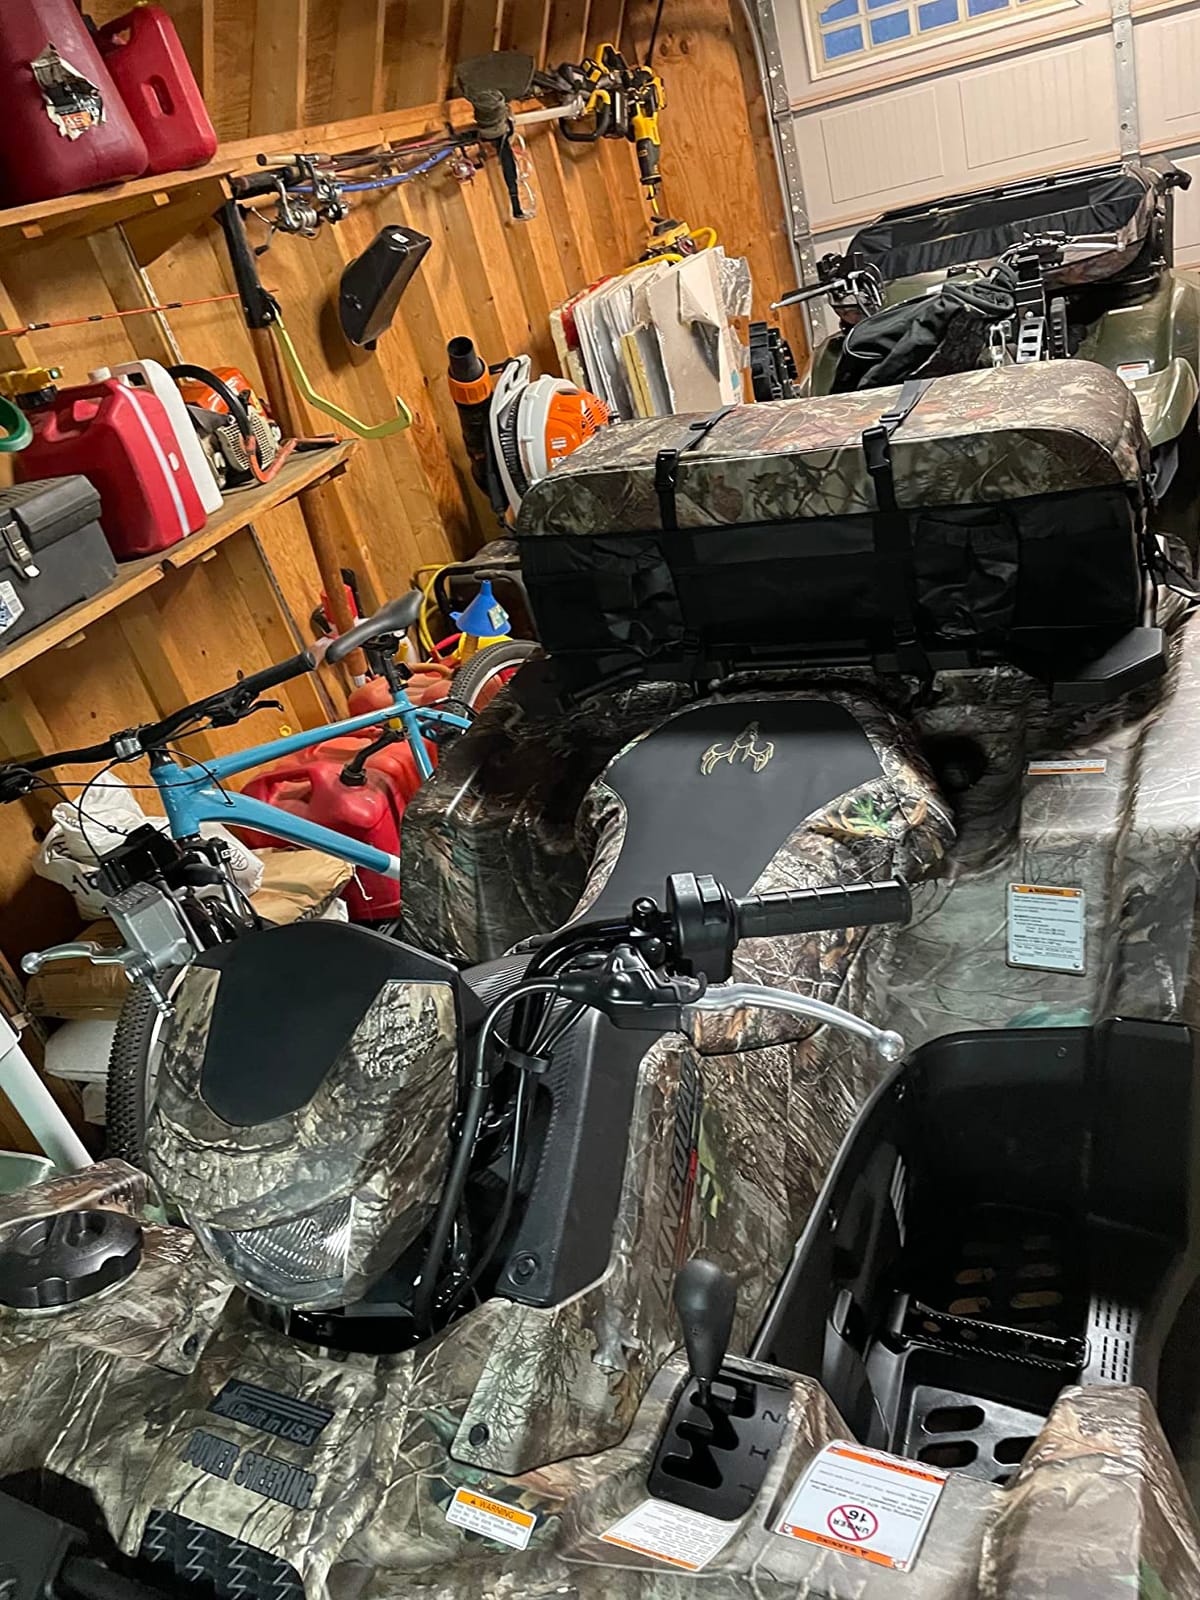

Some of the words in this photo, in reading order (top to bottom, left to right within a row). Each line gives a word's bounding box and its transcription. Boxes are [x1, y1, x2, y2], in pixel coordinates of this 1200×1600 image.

[279, 1420, 316, 1445] USA
[180, 1429, 241, 1481] POWER
[234, 1450, 318, 1511] STEERING
[480, 1500, 515, 1519] WARNING
[847, 1509, 869, 1524] 16
[832, 1517, 870, 1535] UNDER
